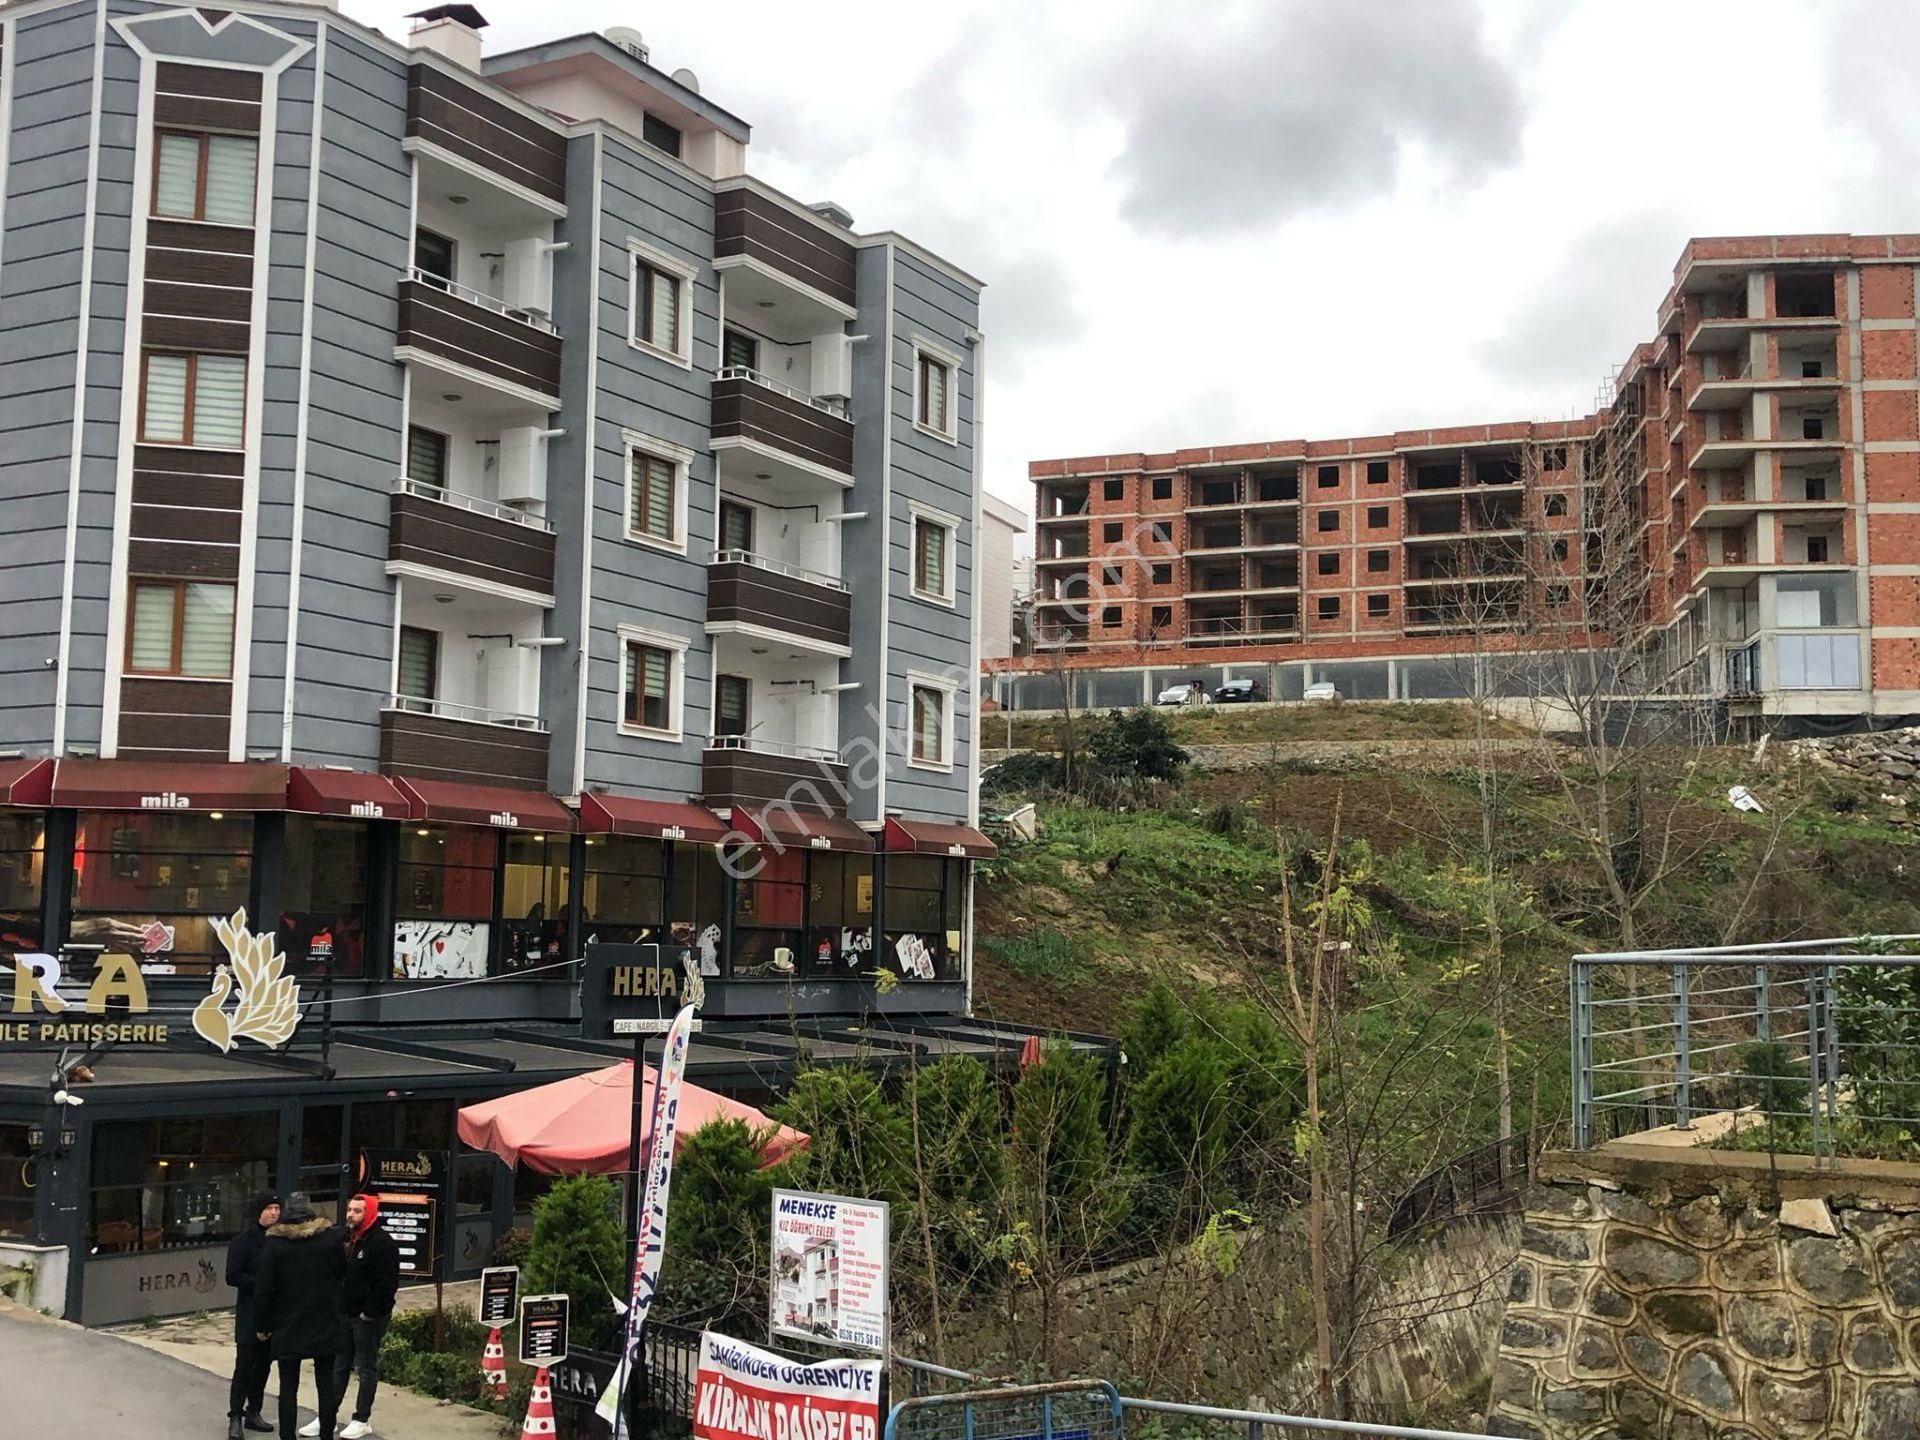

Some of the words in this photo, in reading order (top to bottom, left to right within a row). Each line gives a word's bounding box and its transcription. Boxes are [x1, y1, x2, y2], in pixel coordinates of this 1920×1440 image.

[141, 793, 190, 808] mila
[351, 801, 383, 817] mila
[490, 812, 518, 826] mila
[662, 826, 686, 839] mila
[811, 836, 831, 848] mila
[949, 844, 966, 856] mila
[613, 966, 677, 996] HERA
[41, 1023, 168, 1042] PATISSERIE
[614, 1021, 631, 1031] CAFE
[381, 1161, 416, 1173] HERA
[779, 1198, 837, 1222] MENEKŞE
[139, 1271, 191, 1292] HERA
[709, 1341, 778, 1381] SAHİBİNDEN
